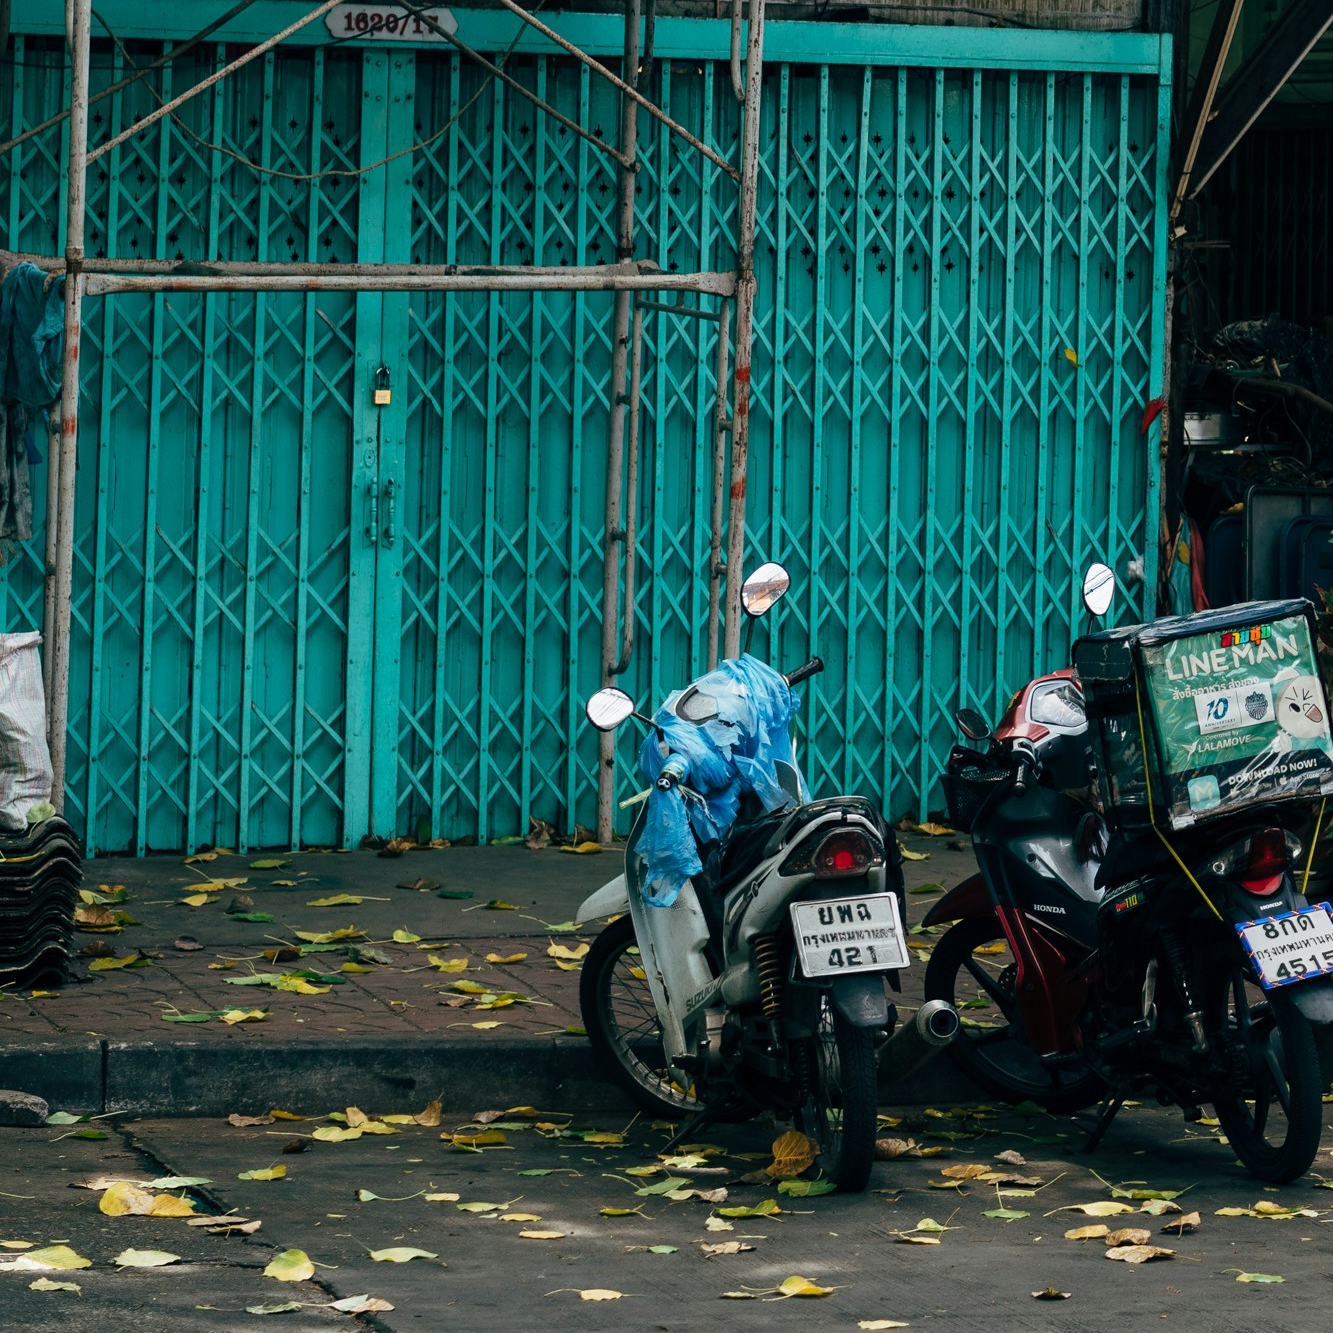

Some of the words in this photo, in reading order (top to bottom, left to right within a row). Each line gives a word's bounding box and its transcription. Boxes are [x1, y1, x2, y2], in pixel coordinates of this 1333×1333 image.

[1165, 647, 1229, 680] LINE
[1231, 634, 1298, 669] MAN
[1197, 734, 1252, 754] LALAMOVE
[1289, 758, 1318, 771] NOW!
[1033, 903, 1067, 915] HONDA
[1260, 901, 1283, 911] HONDA
[1262, 914, 1315, 939] 8กด
[802, 928, 897, 949] กรุงเทพมหานคร
[828, 945, 878, 967] 421
